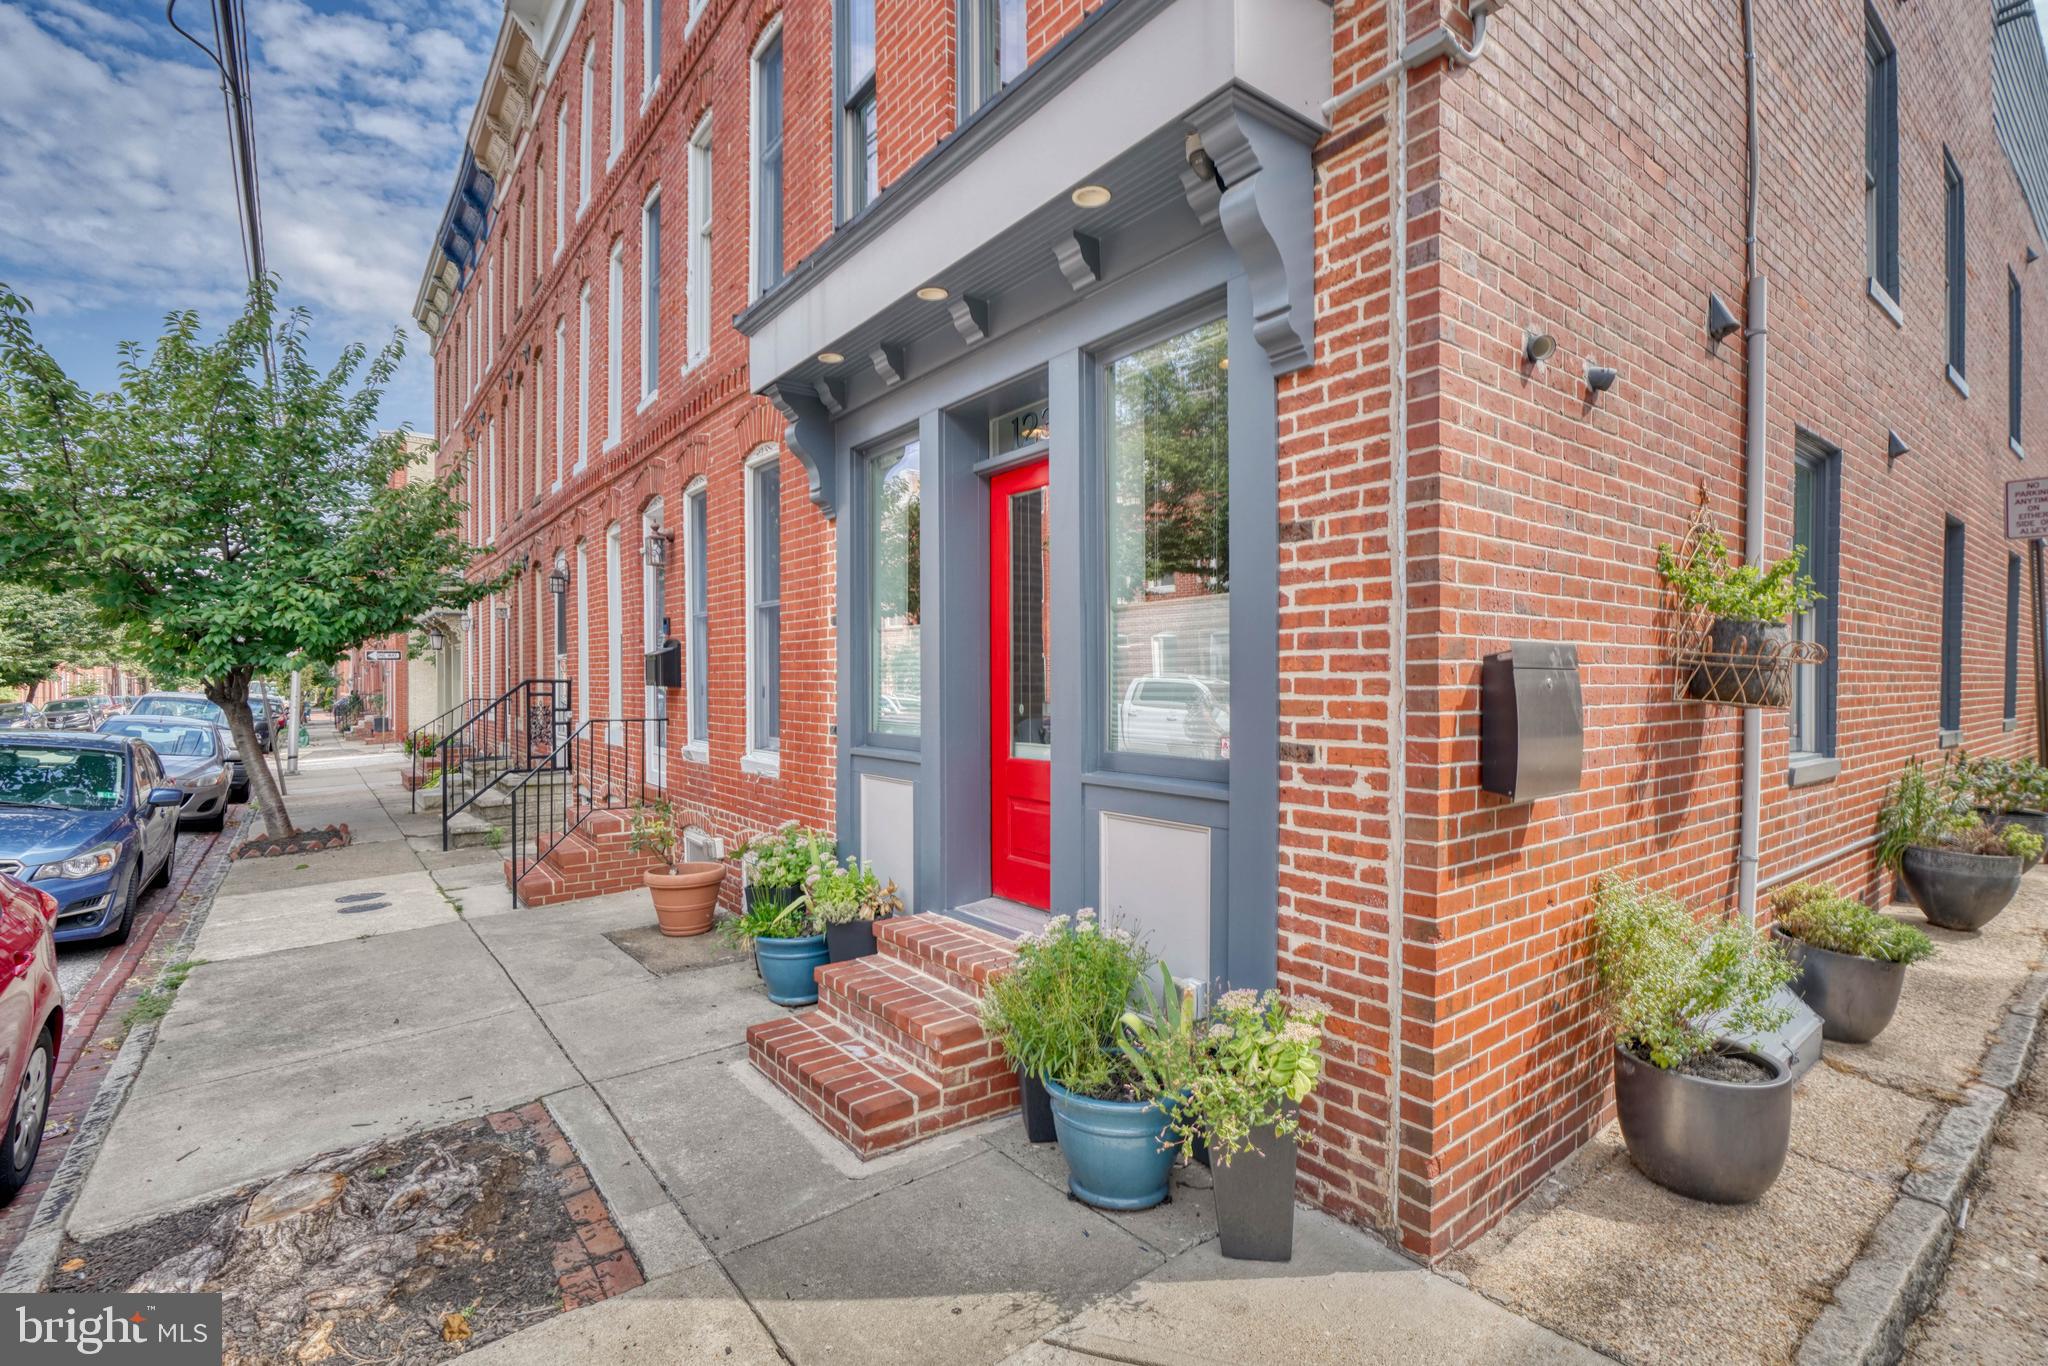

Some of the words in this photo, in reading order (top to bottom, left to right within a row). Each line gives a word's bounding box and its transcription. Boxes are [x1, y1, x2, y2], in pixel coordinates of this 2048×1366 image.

[2015, 489, 2048, 498] PARKIN
[2015, 497, 2048, 505] ANYTIM
[2016, 520, 2034, 528] SIDE
[2020, 526, 2047, 534] ALLEY
